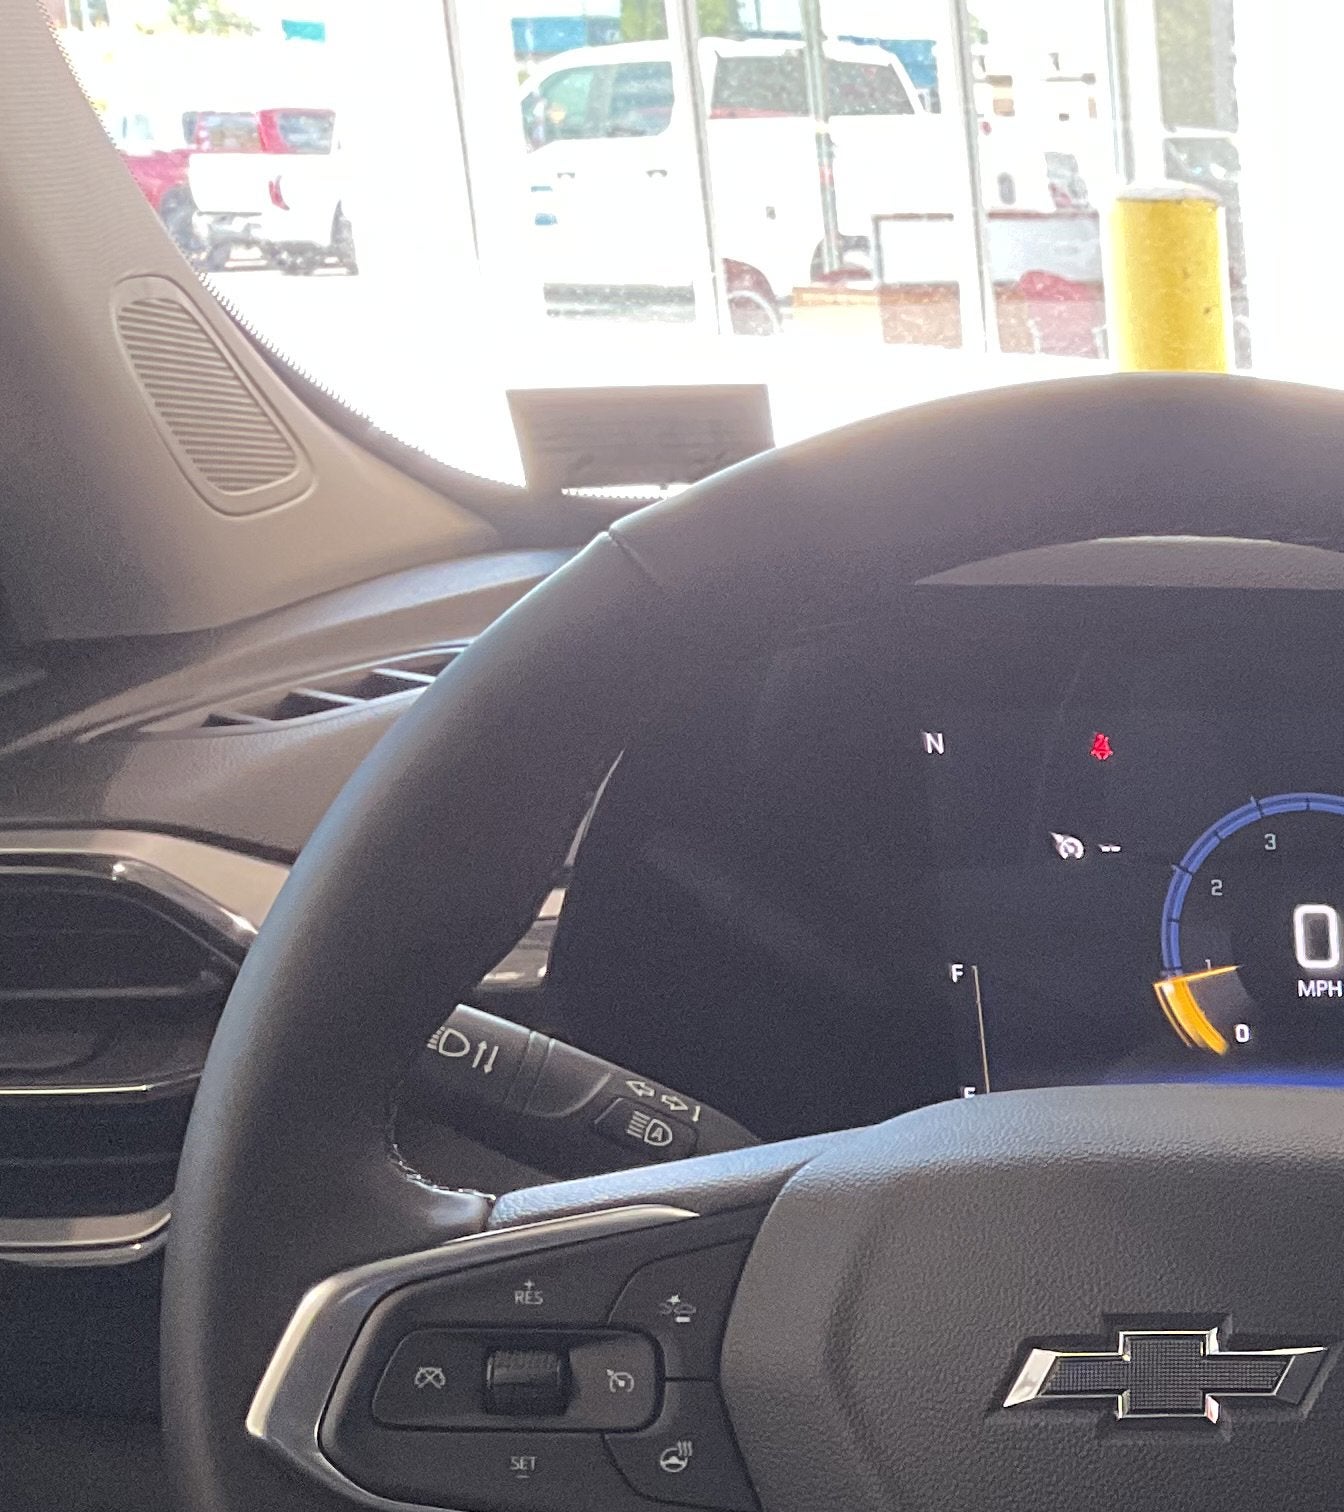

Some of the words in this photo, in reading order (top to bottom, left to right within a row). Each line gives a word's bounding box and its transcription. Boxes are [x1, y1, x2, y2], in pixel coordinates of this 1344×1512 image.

[925, 732, 944, 754] N
[1263, 833, 1277, 852] 3
[1209, 879, 1224, 897] 2
[1293, 904, 1340, 969] 0
[950, 963, 964, 984] F
[1297, 980, 1343, 998] MPH
[1235, 1023, 1251, 1044] 0
[514, 1290, 543, 1306] RES
[510, 1456, 538, 1471] SET
